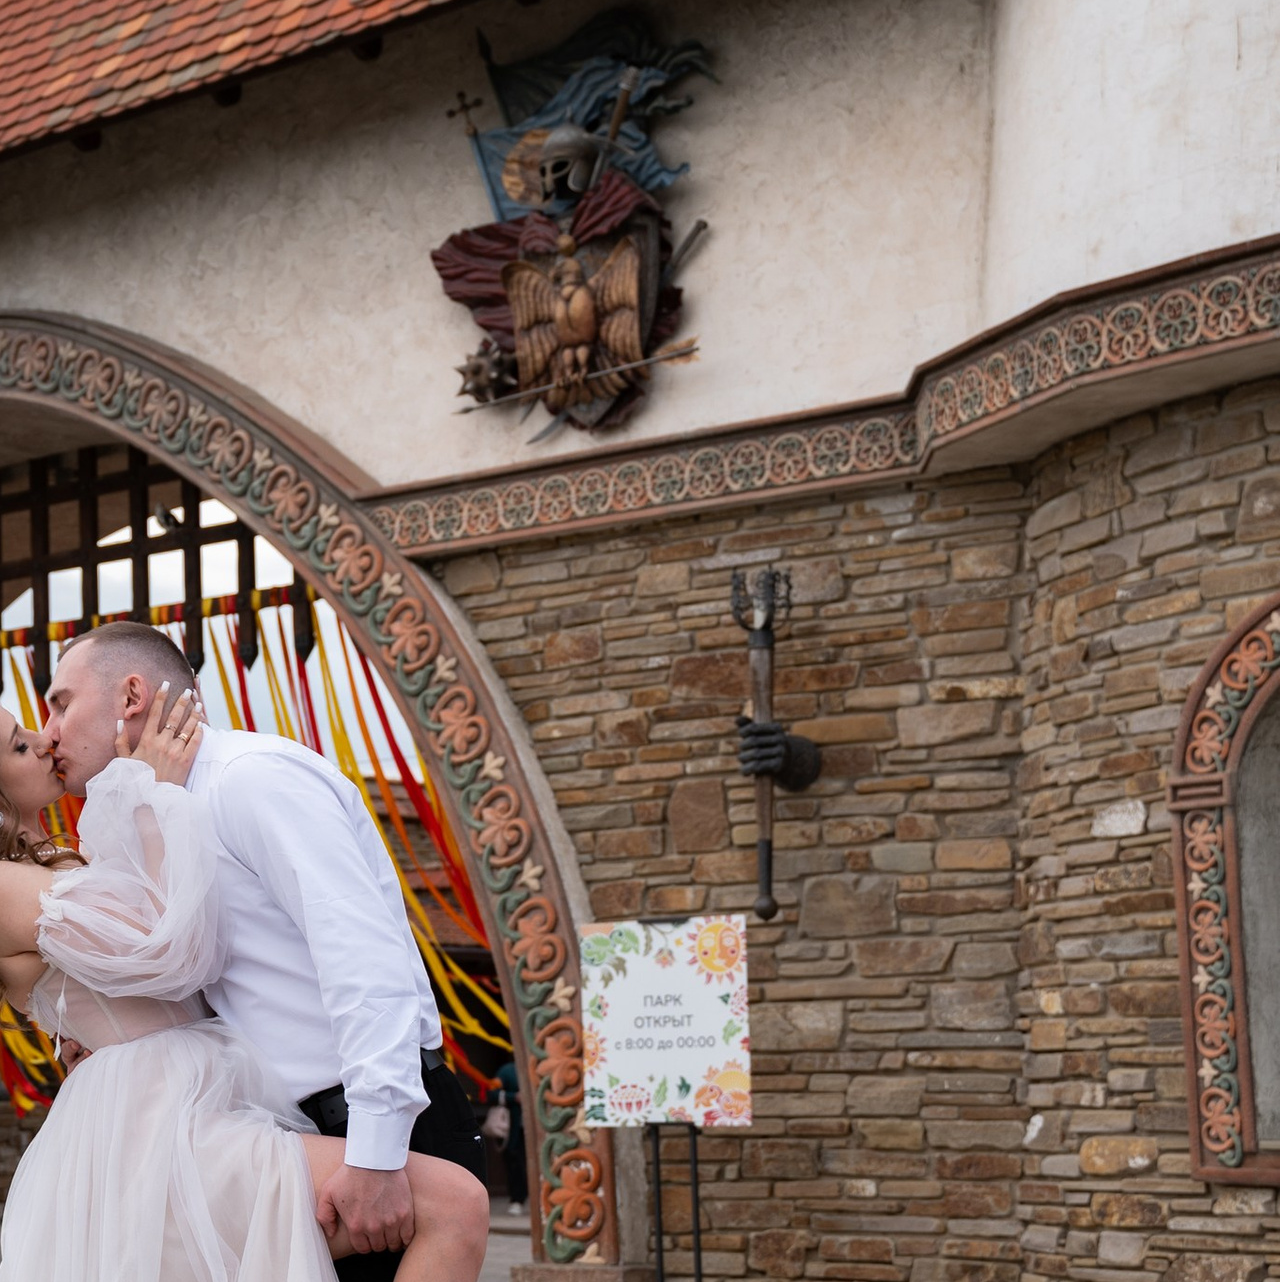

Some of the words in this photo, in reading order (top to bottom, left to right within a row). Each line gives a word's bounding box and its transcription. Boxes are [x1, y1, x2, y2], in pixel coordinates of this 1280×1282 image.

[643, 994, 683, 1007] ПАРК
[634, 1014, 693, 1029] ОТКРЫТ
[614, 1041, 622, 1050] с
[625, 1037, 654, 1050] 8:00
[657, 1039, 673, 1050] до
[676, 1035, 716, 1048] 00:00
